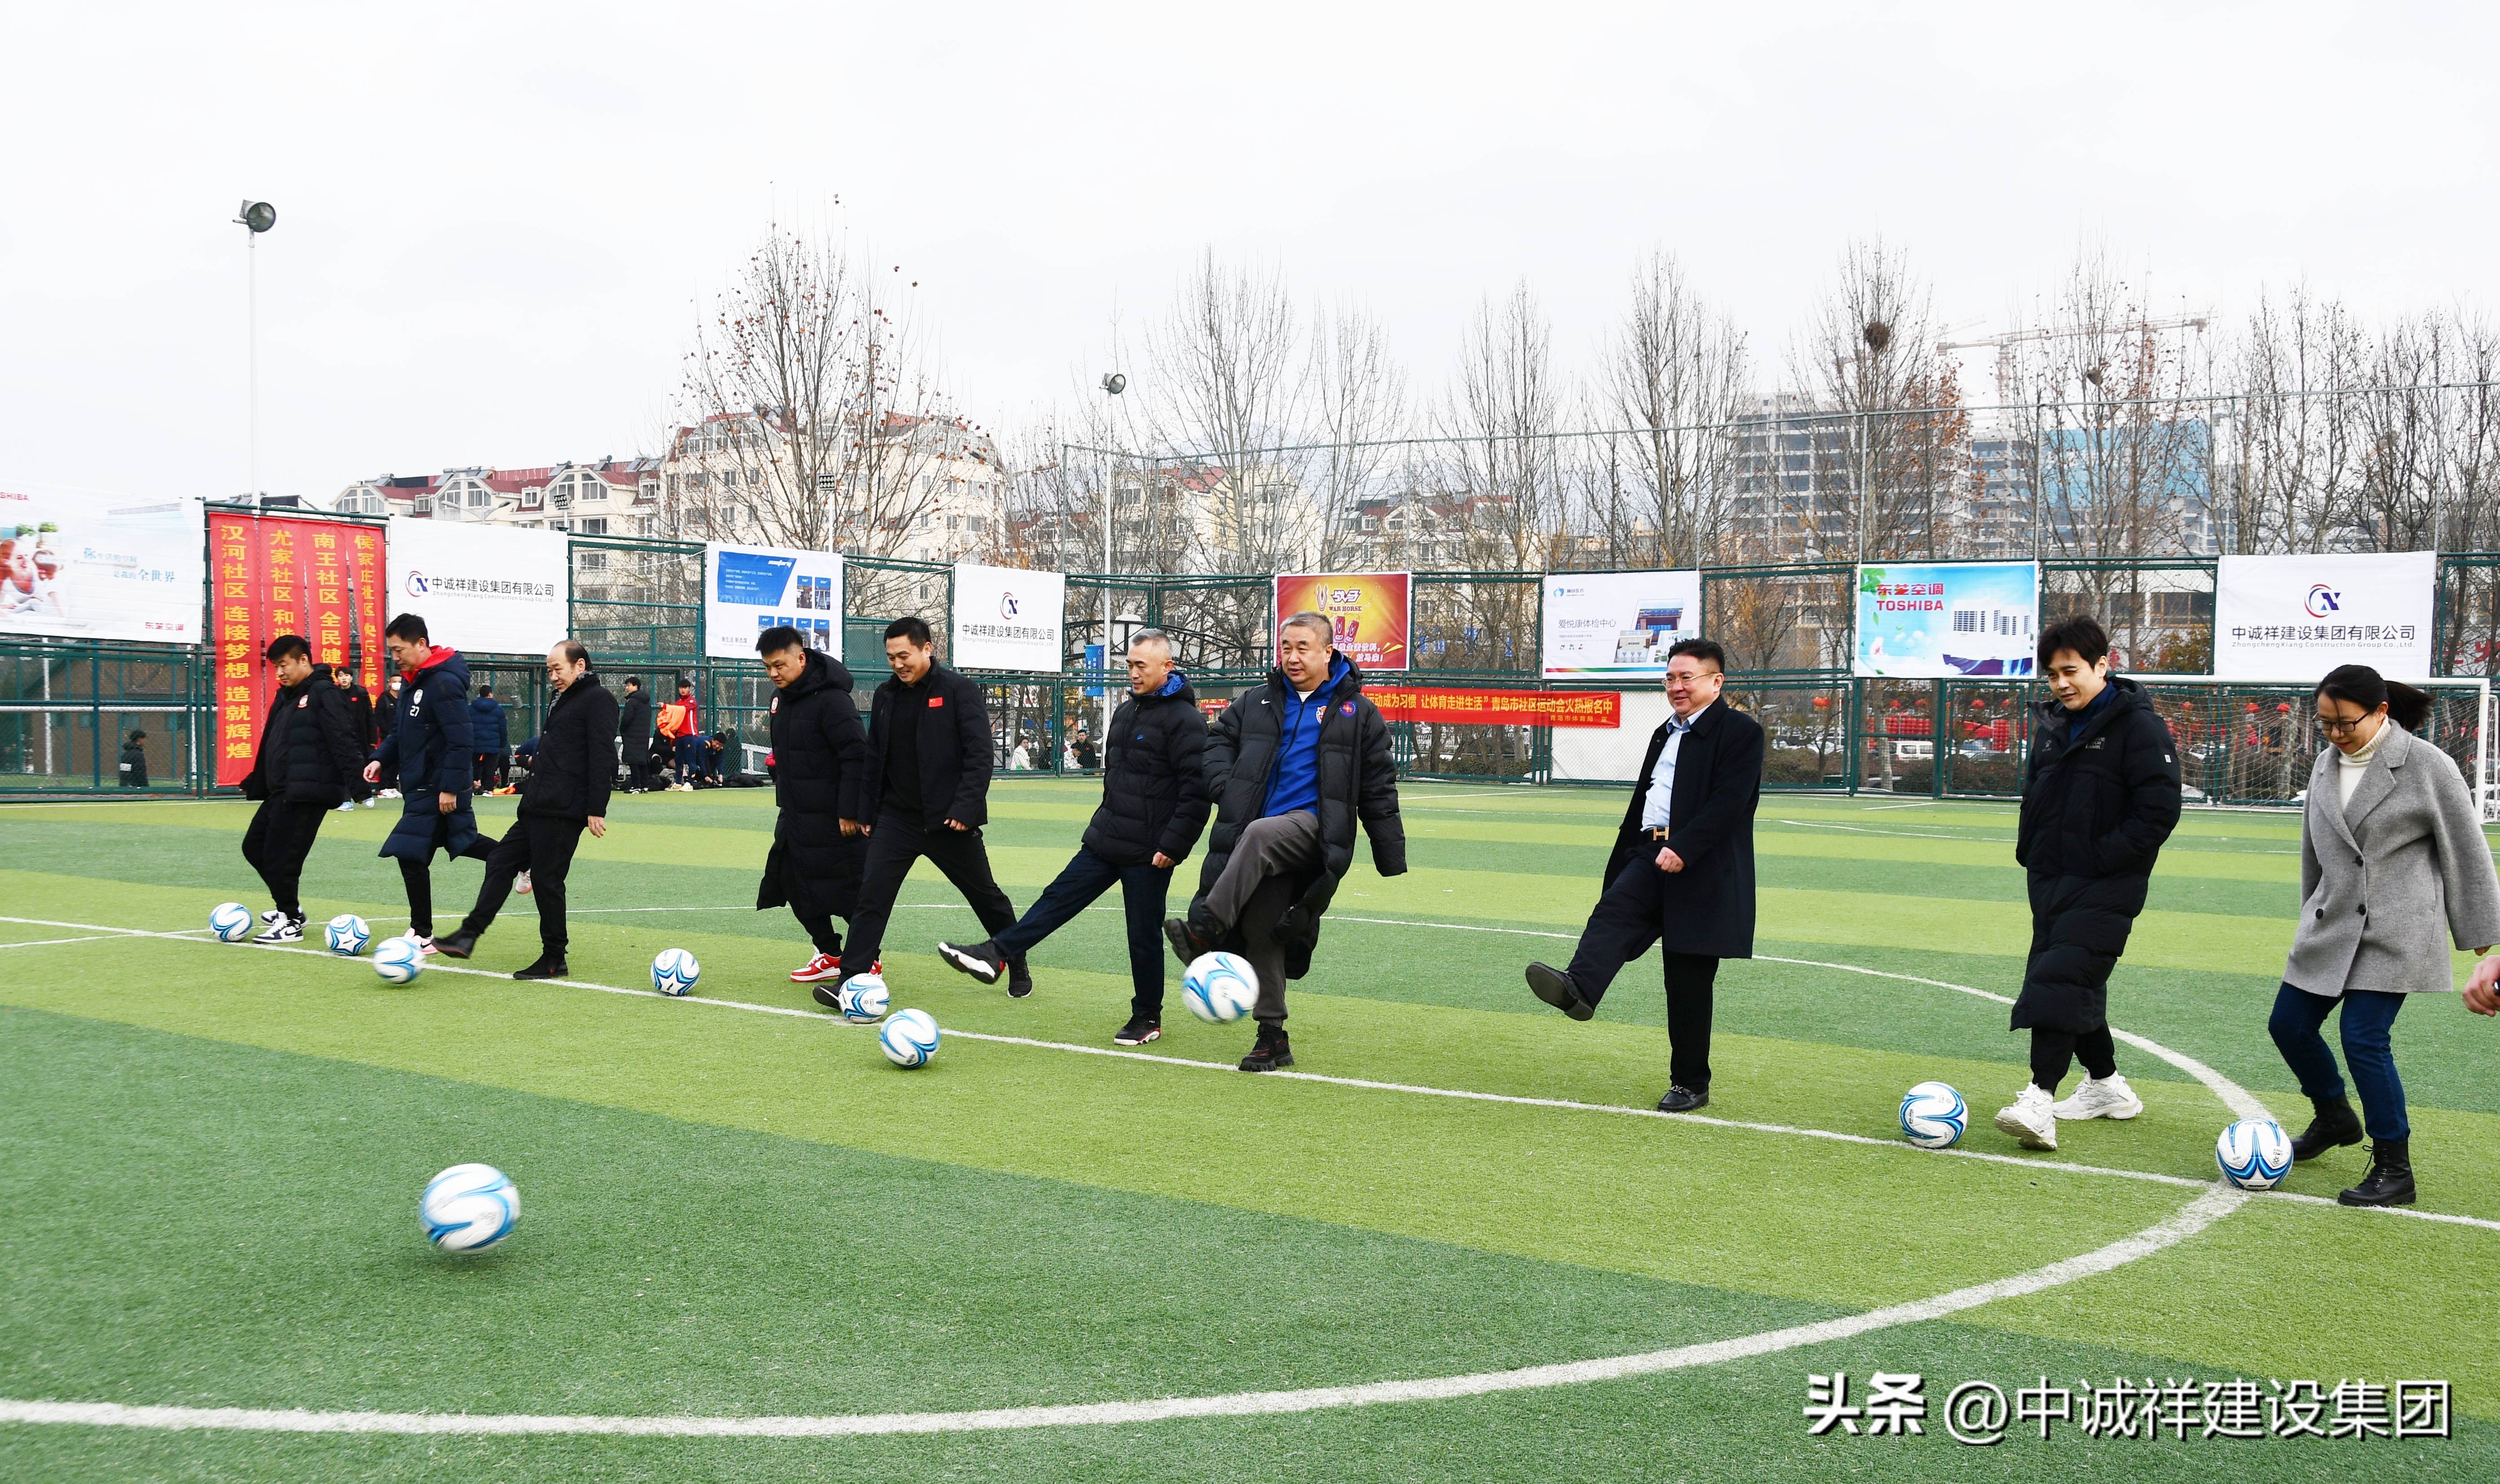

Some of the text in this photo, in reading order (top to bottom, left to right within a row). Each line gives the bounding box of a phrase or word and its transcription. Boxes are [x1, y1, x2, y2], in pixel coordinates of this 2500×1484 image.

[269, 529, 294, 602] 尤家社区
[432, 577, 554, 597] 中诚祥建设集团有限公司
[1877, 583, 1944, 595] 东芝空调
[312, 533, 343, 683] 南王社区 全民健
[1876, 600, 1944, 611] TOSHIBA
[963, 623, 1054, 641] 中诚祥建设集团有限公司
[1558, 618, 1616, 629] 爱悦康体检中心
[2232, 625, 2415, 640] 中诚祥建设集团有限公司
[221, 524, 253, 759] 汉河社区 连接梦想 造就辉煌
[410, 705, 419, 717] 27
[1362, 692, 1417, 709] 运动成为习惯
[1492, 696, 1613, 715] 青岛市社区运动会火热报名中
